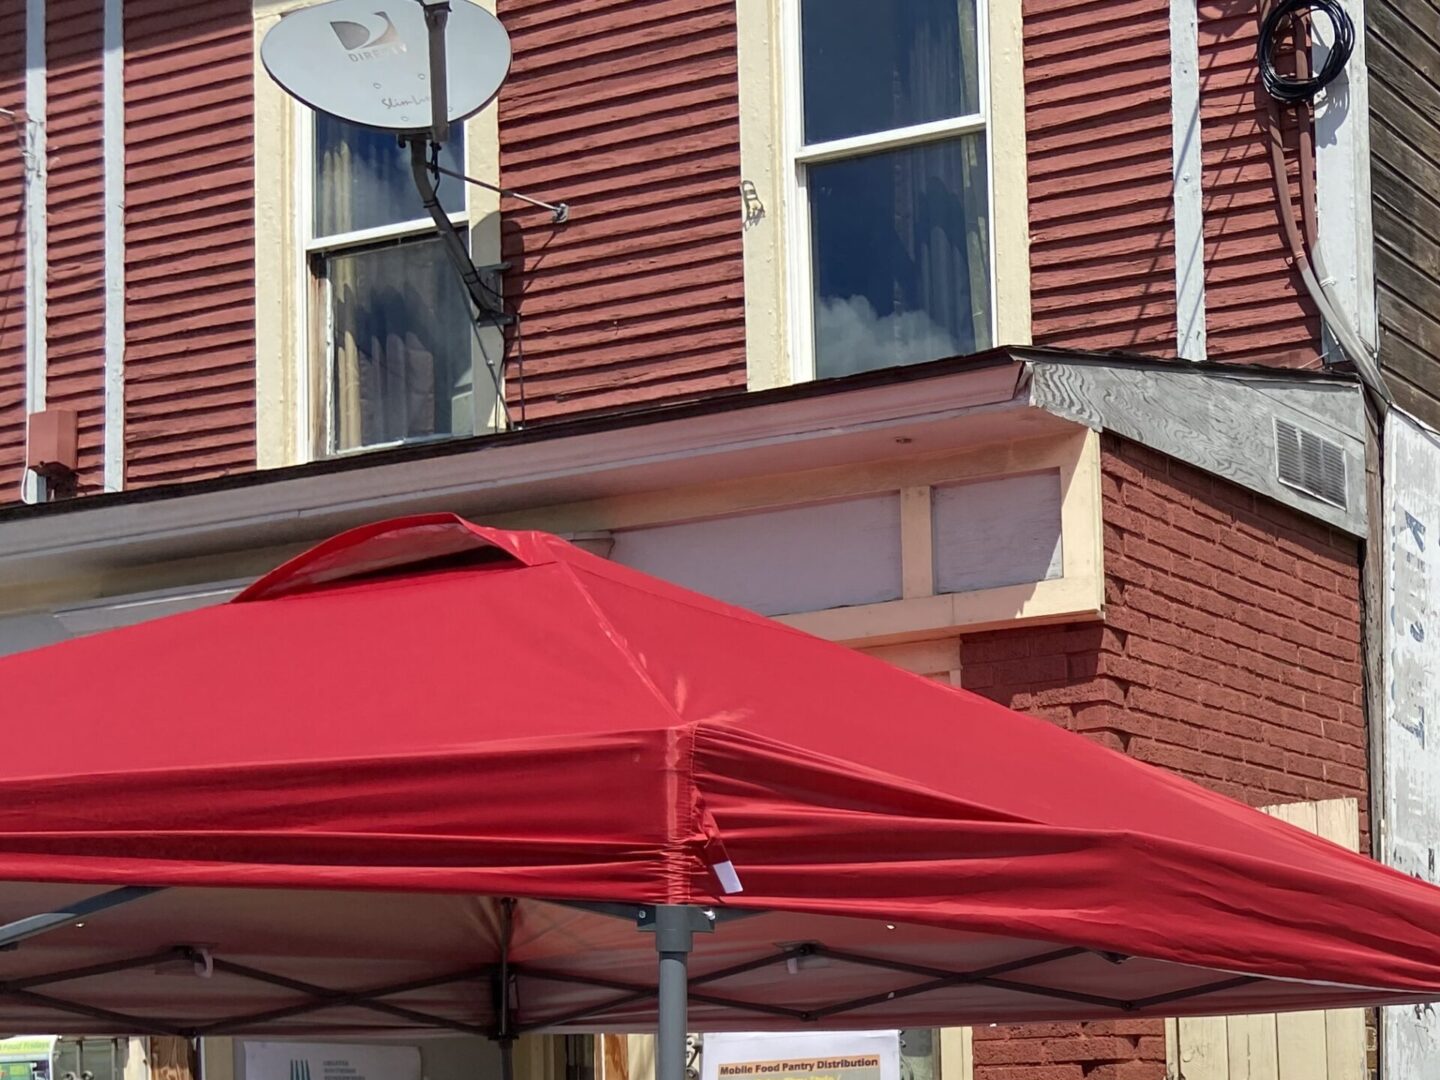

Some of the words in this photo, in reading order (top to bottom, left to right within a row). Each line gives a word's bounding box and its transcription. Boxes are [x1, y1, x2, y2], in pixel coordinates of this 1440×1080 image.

[720, 1065, 753, 1076] Mobile
[755, 1064, 780, 1074] Food
[782, 1061, 815, 1073] Pantry
[816, 1058, 878, 1070] Distribution
